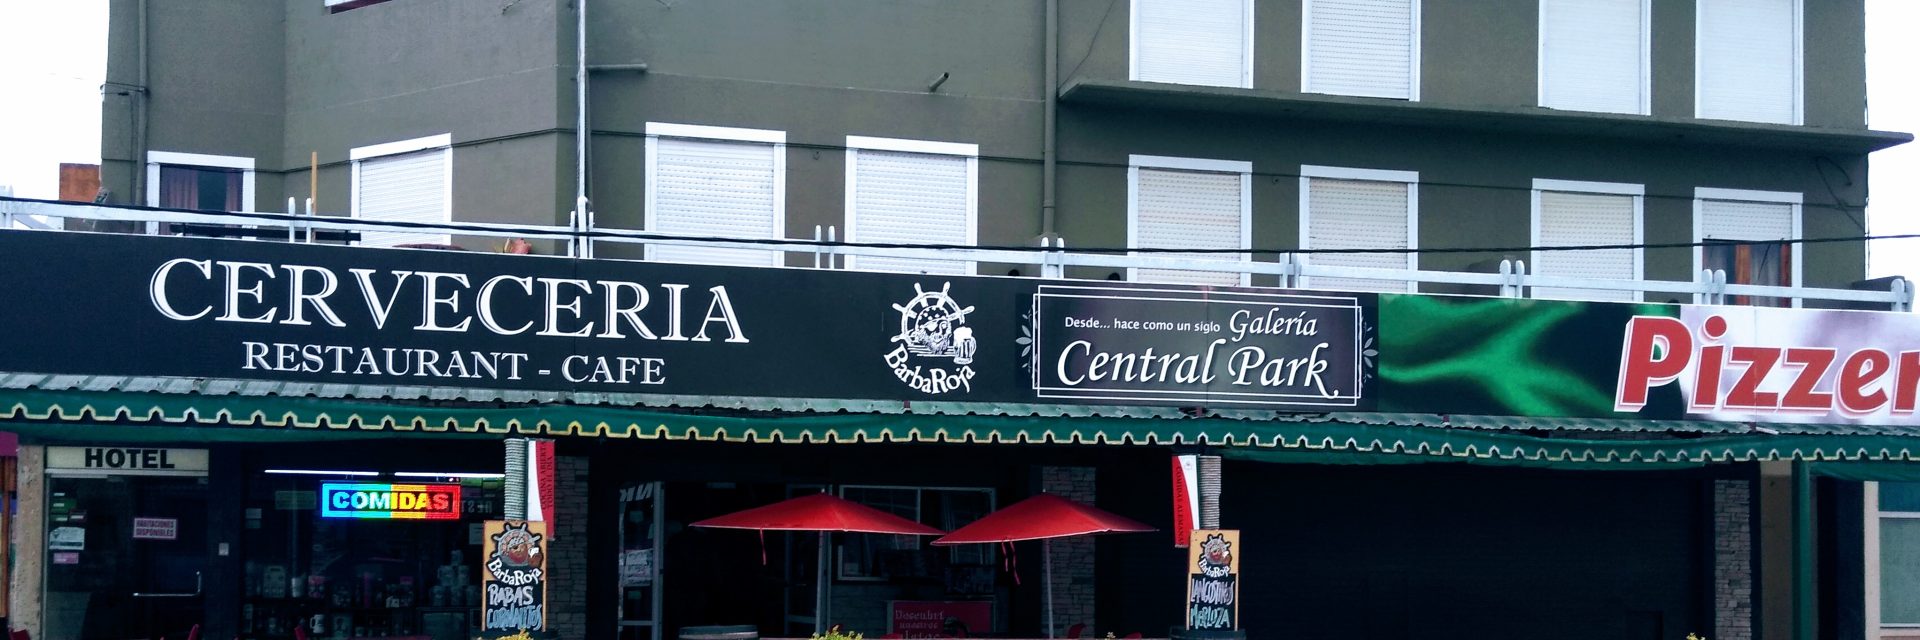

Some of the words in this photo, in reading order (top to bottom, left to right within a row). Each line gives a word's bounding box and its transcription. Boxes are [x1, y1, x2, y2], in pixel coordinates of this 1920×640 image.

[149, 257, 750, 344] CERVECERIA
[1065, 316, 1111, 329] Desde...
[1114, 318, 1140, 330] hace
[1143, 321, 1174, 331] como
[1177, 322, 1191, 332] un
[1194, 320, 1221, 334] siglo
[1229, 307, 1319, 342] Galería
[241, 341, 529, 381] RESTAURANT
[561, 354, 667, 385] CAFE
[883, 343, 976, 394] BarbaRoja
[1057, 338, 1228, 386] Central
[1228, 342, 1340, 399] Park
[85, 447, 175, 469] HOTEL
[332, 491, 450, 510] COMIDAS
[488, 558, 542, 586] BarbaRoja
[1198, 558, 1231, 578] BarbaRoja
[488, 584, 534, 607] RABAS
